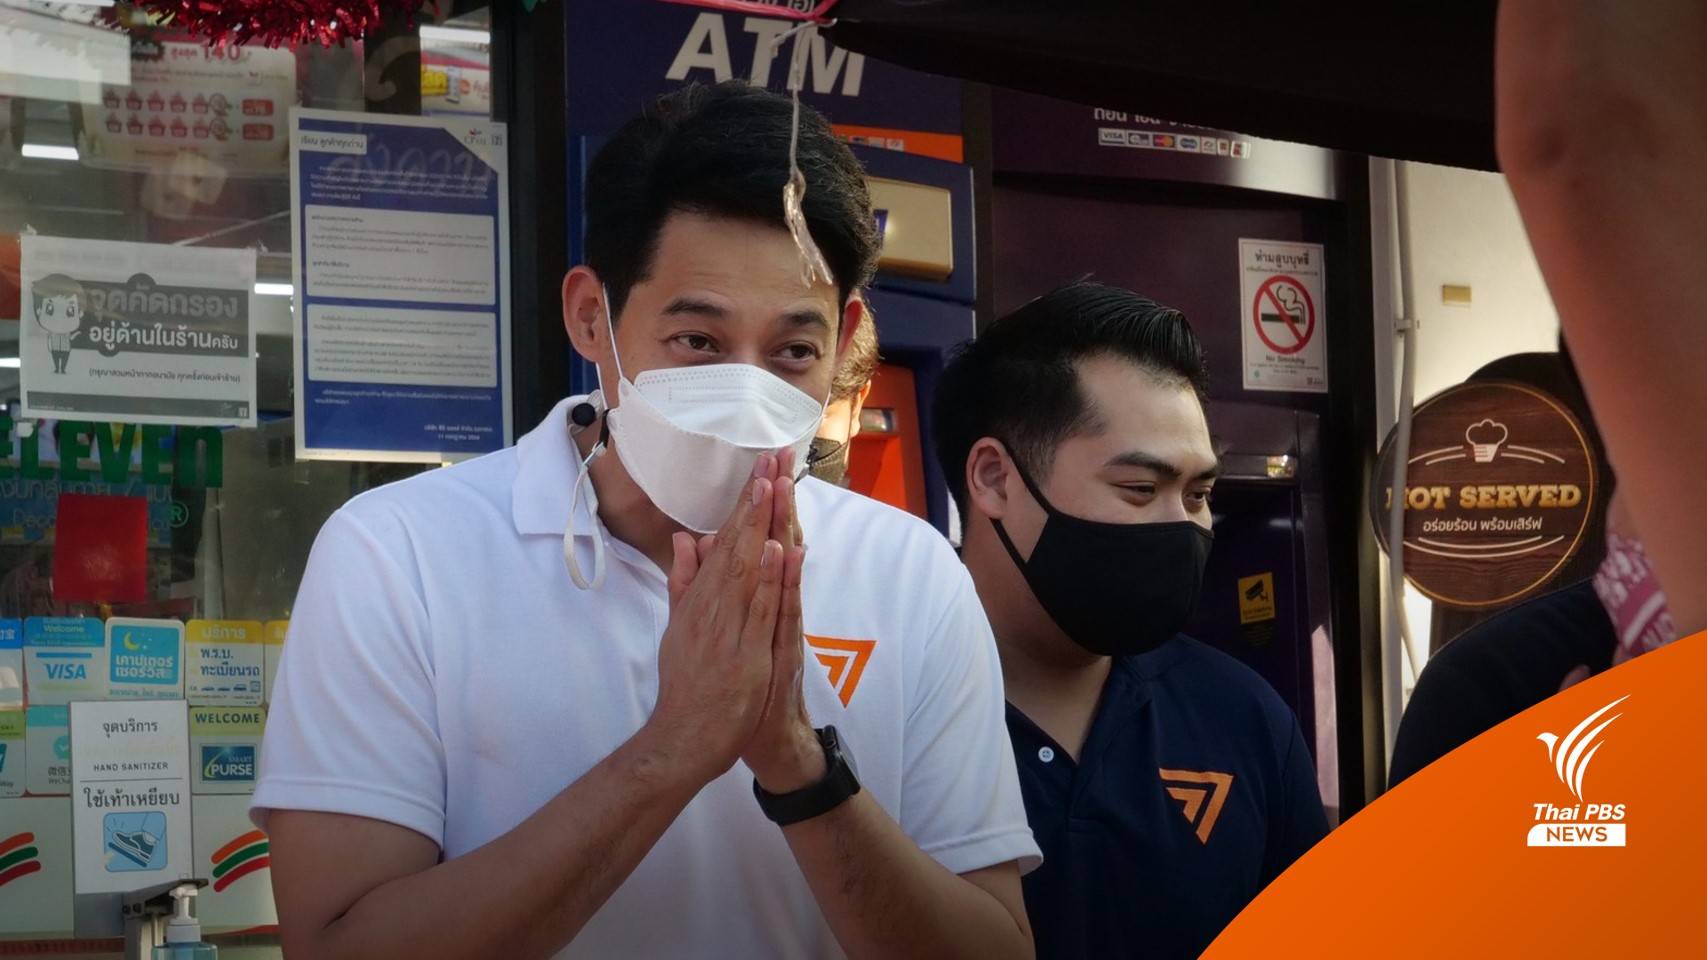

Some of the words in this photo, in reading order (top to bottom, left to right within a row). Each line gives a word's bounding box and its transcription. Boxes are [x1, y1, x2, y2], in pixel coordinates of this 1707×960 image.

[665, 12, 865, 97] ATM
[91, 283, 238, 321] จุดคัดกรอง
[1459, 484, 1582, 509] SERVED
[1423, 518, 1477, 533] อร่อยร้อน
[1480, 516, 1543, 531] พร้อมเสิร์ฟ
[201, 648, 234, 659] พ.ร.บ.
[46, 663, 87, 679] VISA
[201, 661, 260, 677] ทะเบียนรถ
[195, 712, 260, 724] WELCOME
[103, 717, 158, 738] จุดบริการ
[94, 764, 118, 772] HAND
[122, 762, 169, 771] SANITIZER
[211, 763, 253, 776] PURSE
[84, 787, 181, 809] ใช้เท้าเหยียบ
